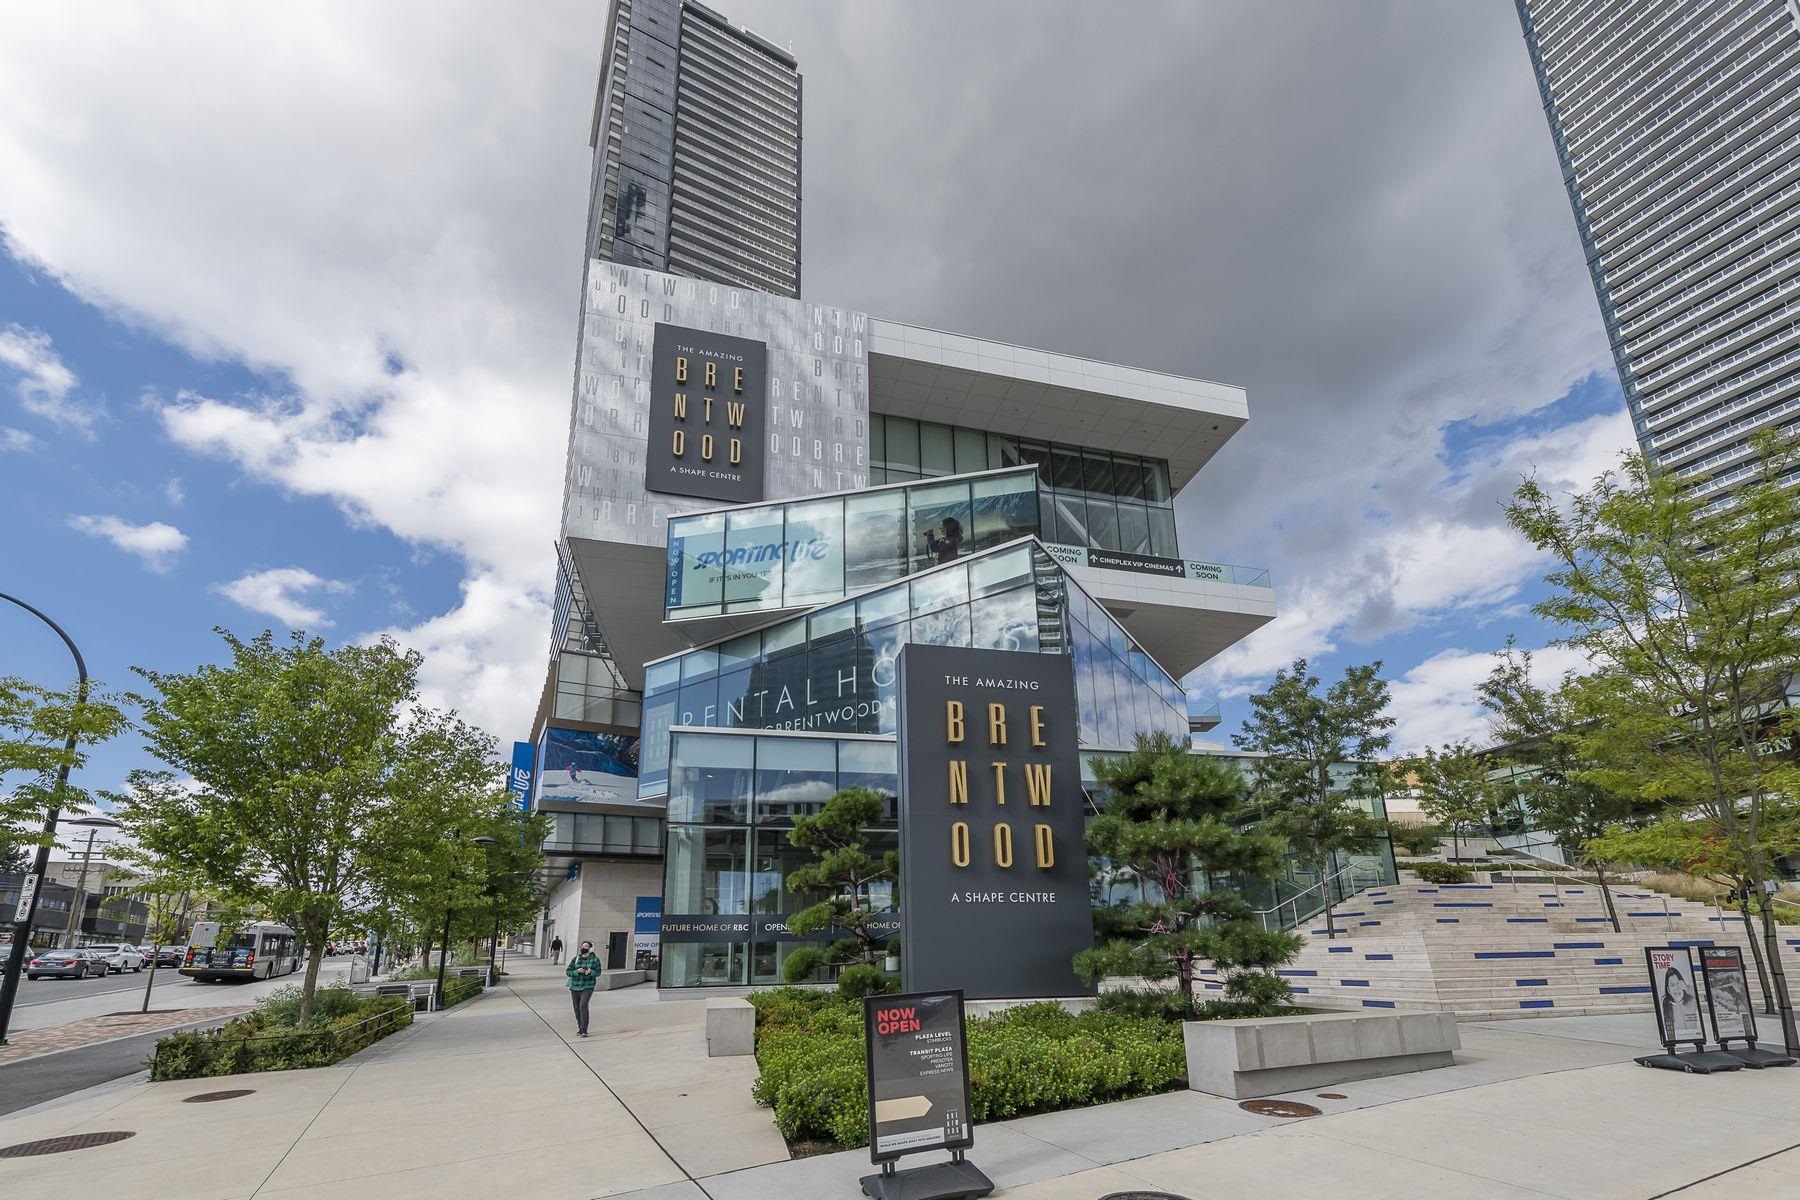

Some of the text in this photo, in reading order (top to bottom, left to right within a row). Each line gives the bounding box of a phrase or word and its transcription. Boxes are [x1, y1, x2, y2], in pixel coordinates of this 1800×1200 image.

[677, 345, 744, 362] THE AMAZING
[679, 467, 706, 477] SHAPE
[709, 471, 742, 482] CENTRE
[671, 541, 680, 567] NOW
[1053, 554, 1078, 563] OON
[1099, 556, 1132, 567] CINEPLEX
[1144, 562, 1174, 572] CINEMAS
[1189, 563, 1222, 573] COMING
[1195, 571, 1219, 580] SOON
[670, 571, 679, 604] OPEN
[944, 675, 1040, 691] THE AMAZING
[951, 892, 1056, 903] A SHAPE CENTRE
[662, 924, 691, 932] FUTURE
[692, 923, 719, 932] HOME
[733, 923, 749, 931] RBC
[764, 923, 791, 931] OPEN
[1652, 953, 1674, 962] STORY
[1654, 961, 1671, 970] TIME
[876, 1008, 916, 1023] NOW
[877, 1019, 921, 1035] OPEN
[909, 1048, 934, 1056] TRANSIT
